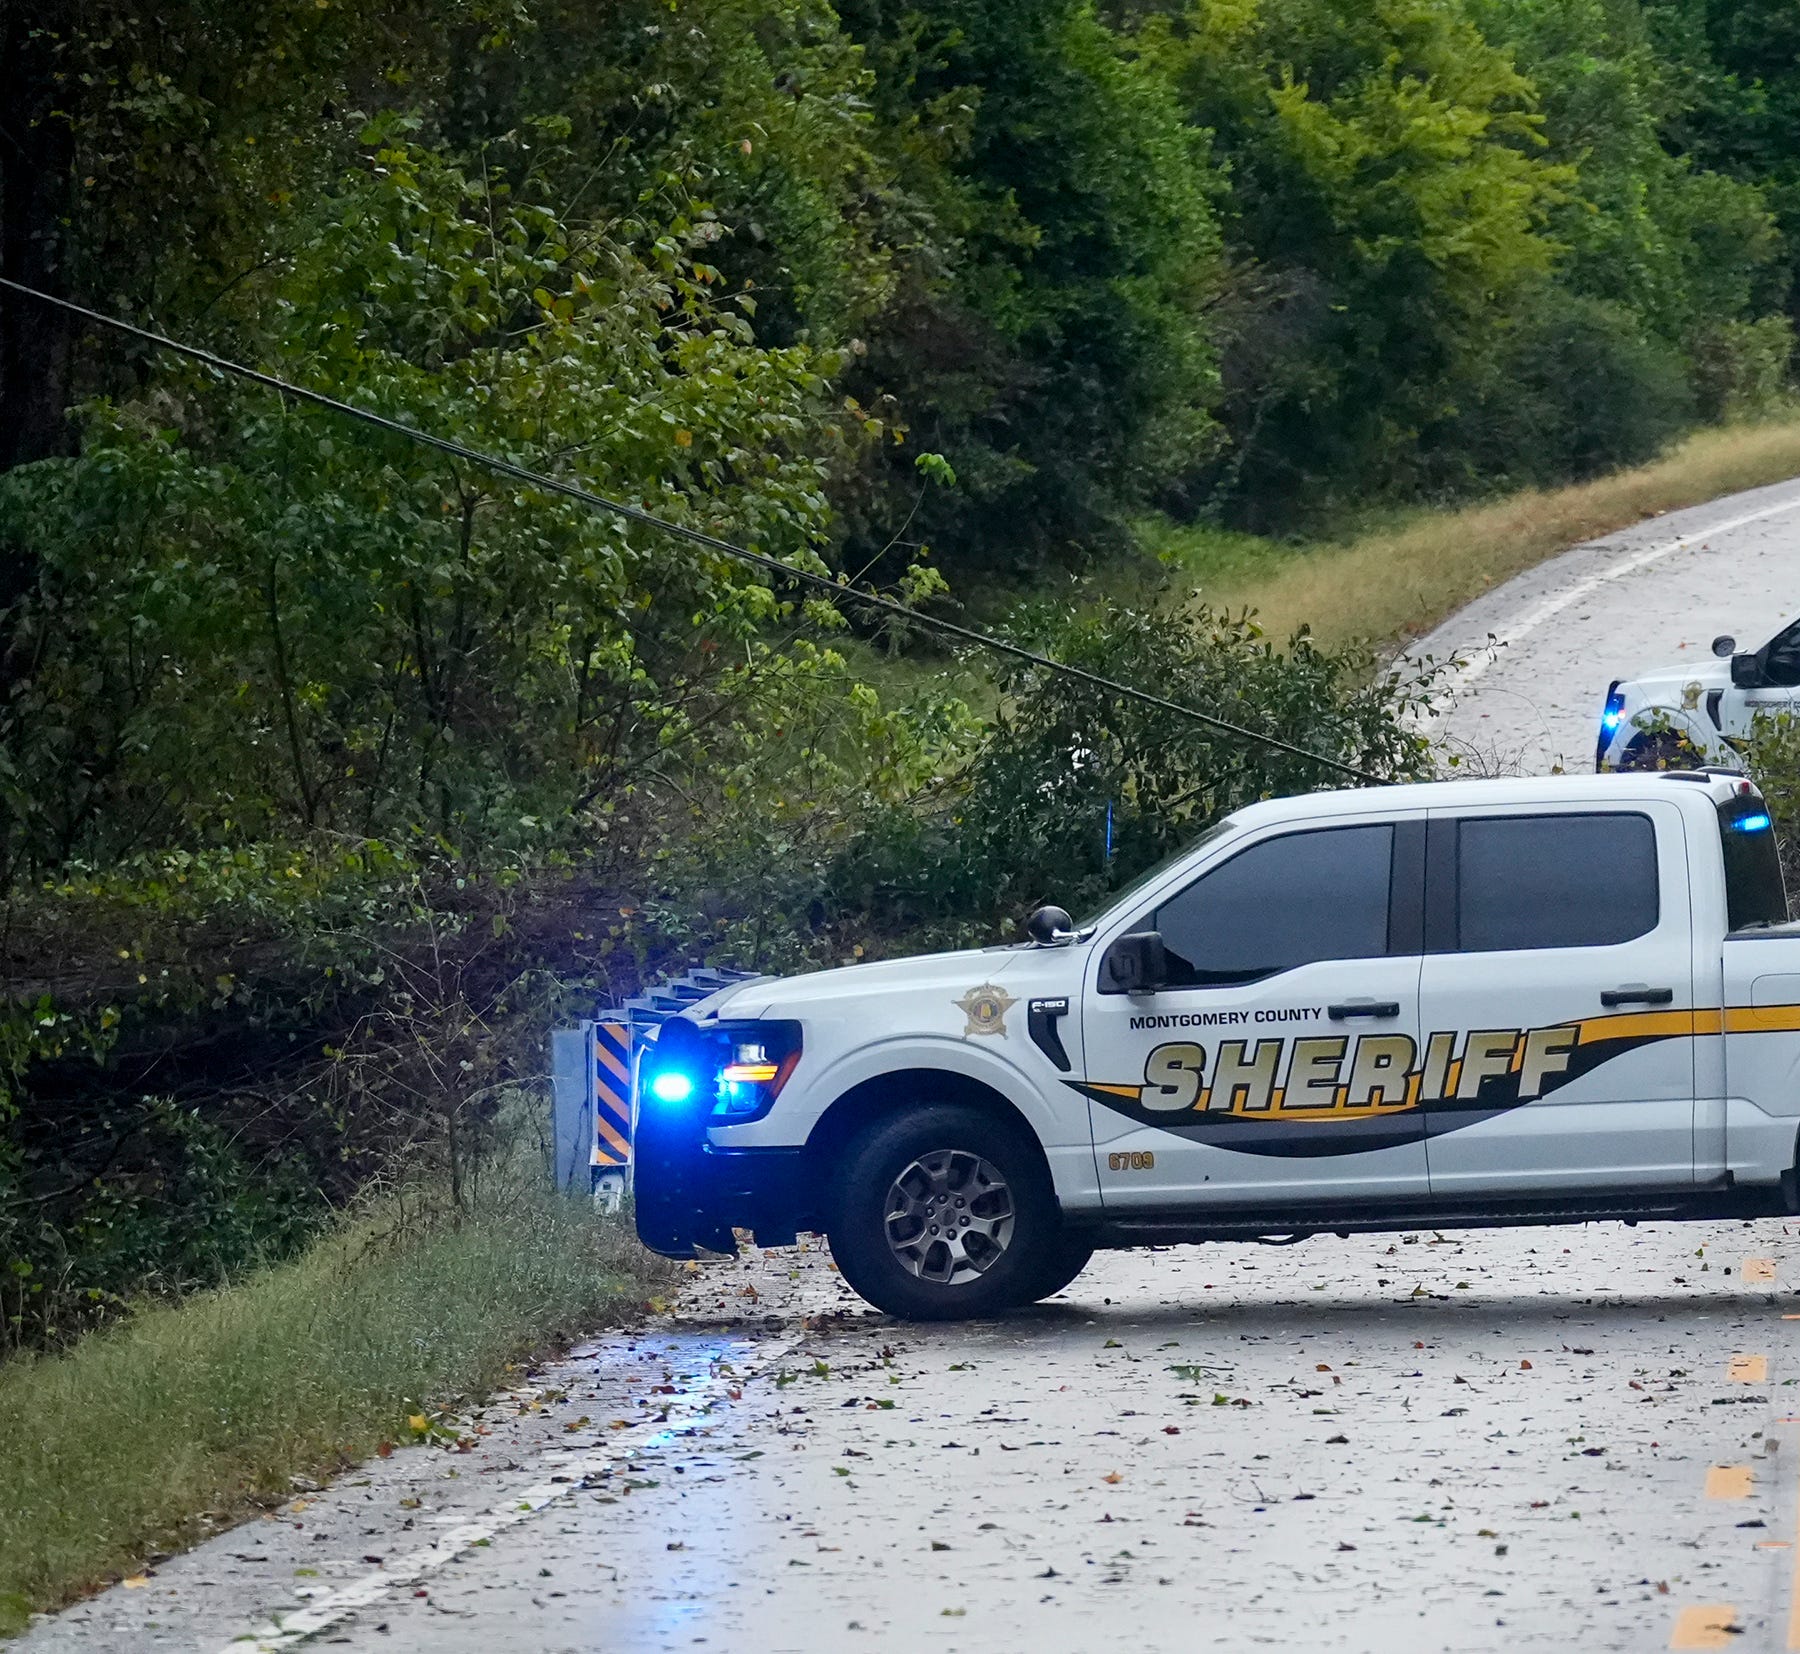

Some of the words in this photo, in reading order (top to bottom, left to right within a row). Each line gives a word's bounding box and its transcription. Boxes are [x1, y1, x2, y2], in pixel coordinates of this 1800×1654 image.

[1130, 1011, 1249, 1030] MONTGOMERY
[1254, 1007, 1322, 1022] COUNTY
[1140, 1025, 1581, 1112] SHERIFF
[1109, 1151, 1154, 1170] 6709
